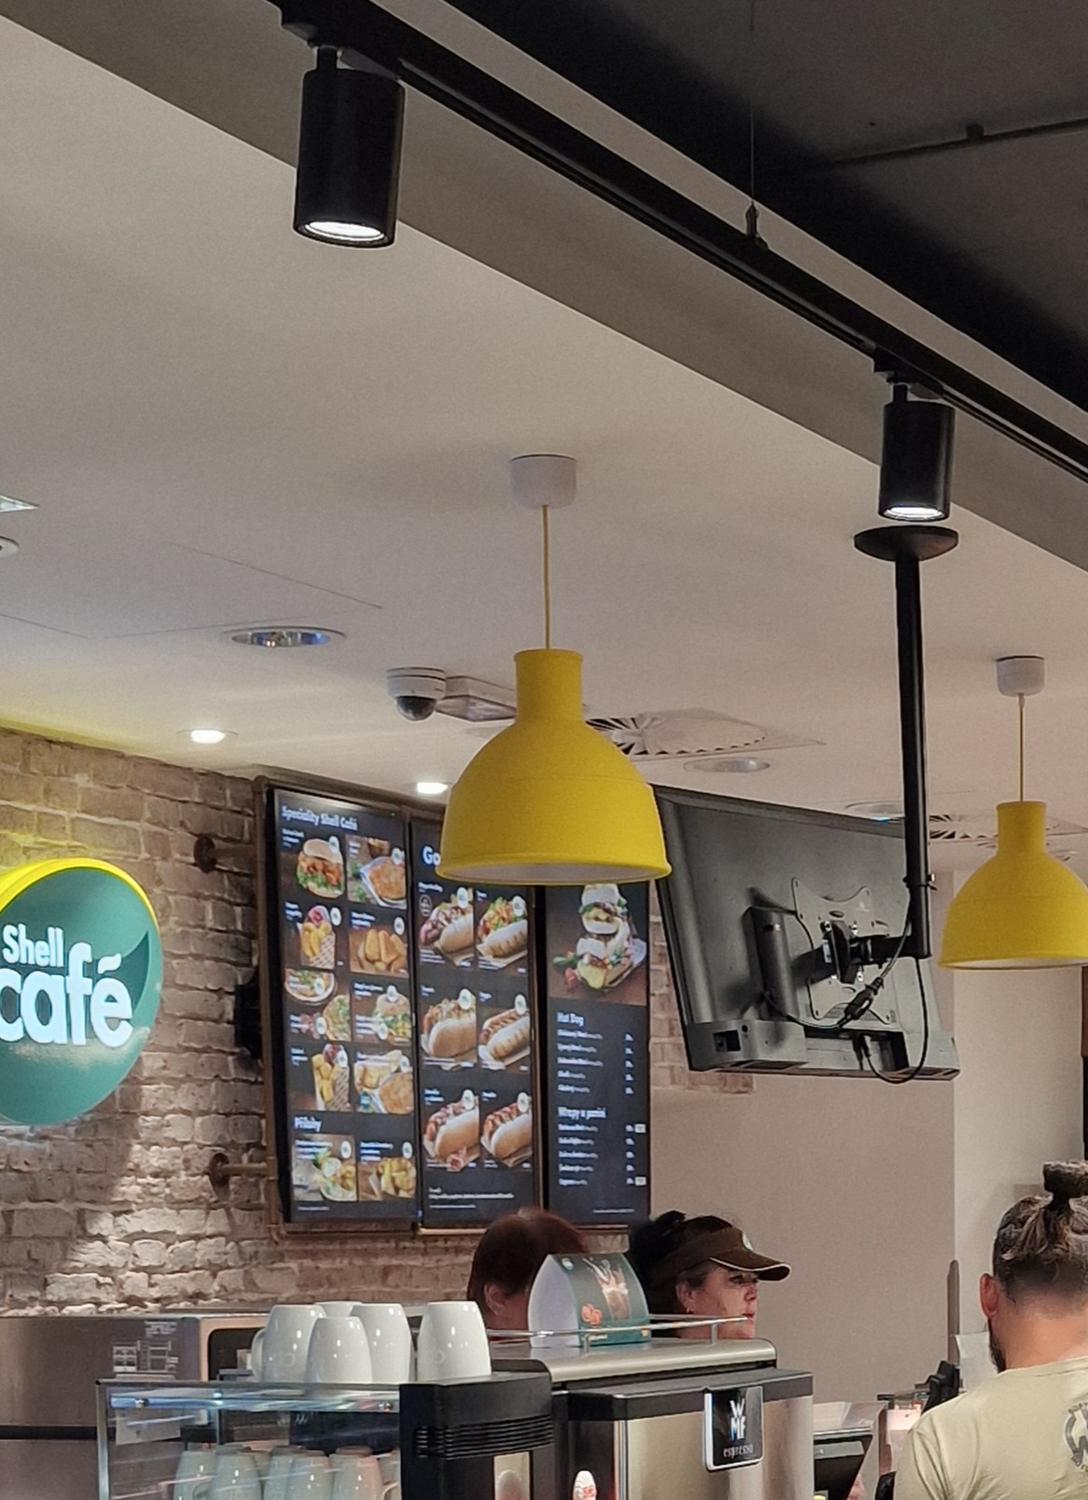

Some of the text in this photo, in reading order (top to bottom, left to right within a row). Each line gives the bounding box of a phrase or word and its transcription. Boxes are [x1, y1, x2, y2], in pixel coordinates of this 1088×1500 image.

[422, 845, 441, 866] Go
[2, 923, 65, 968] Shell
[0, 942, 134, 1048] café
